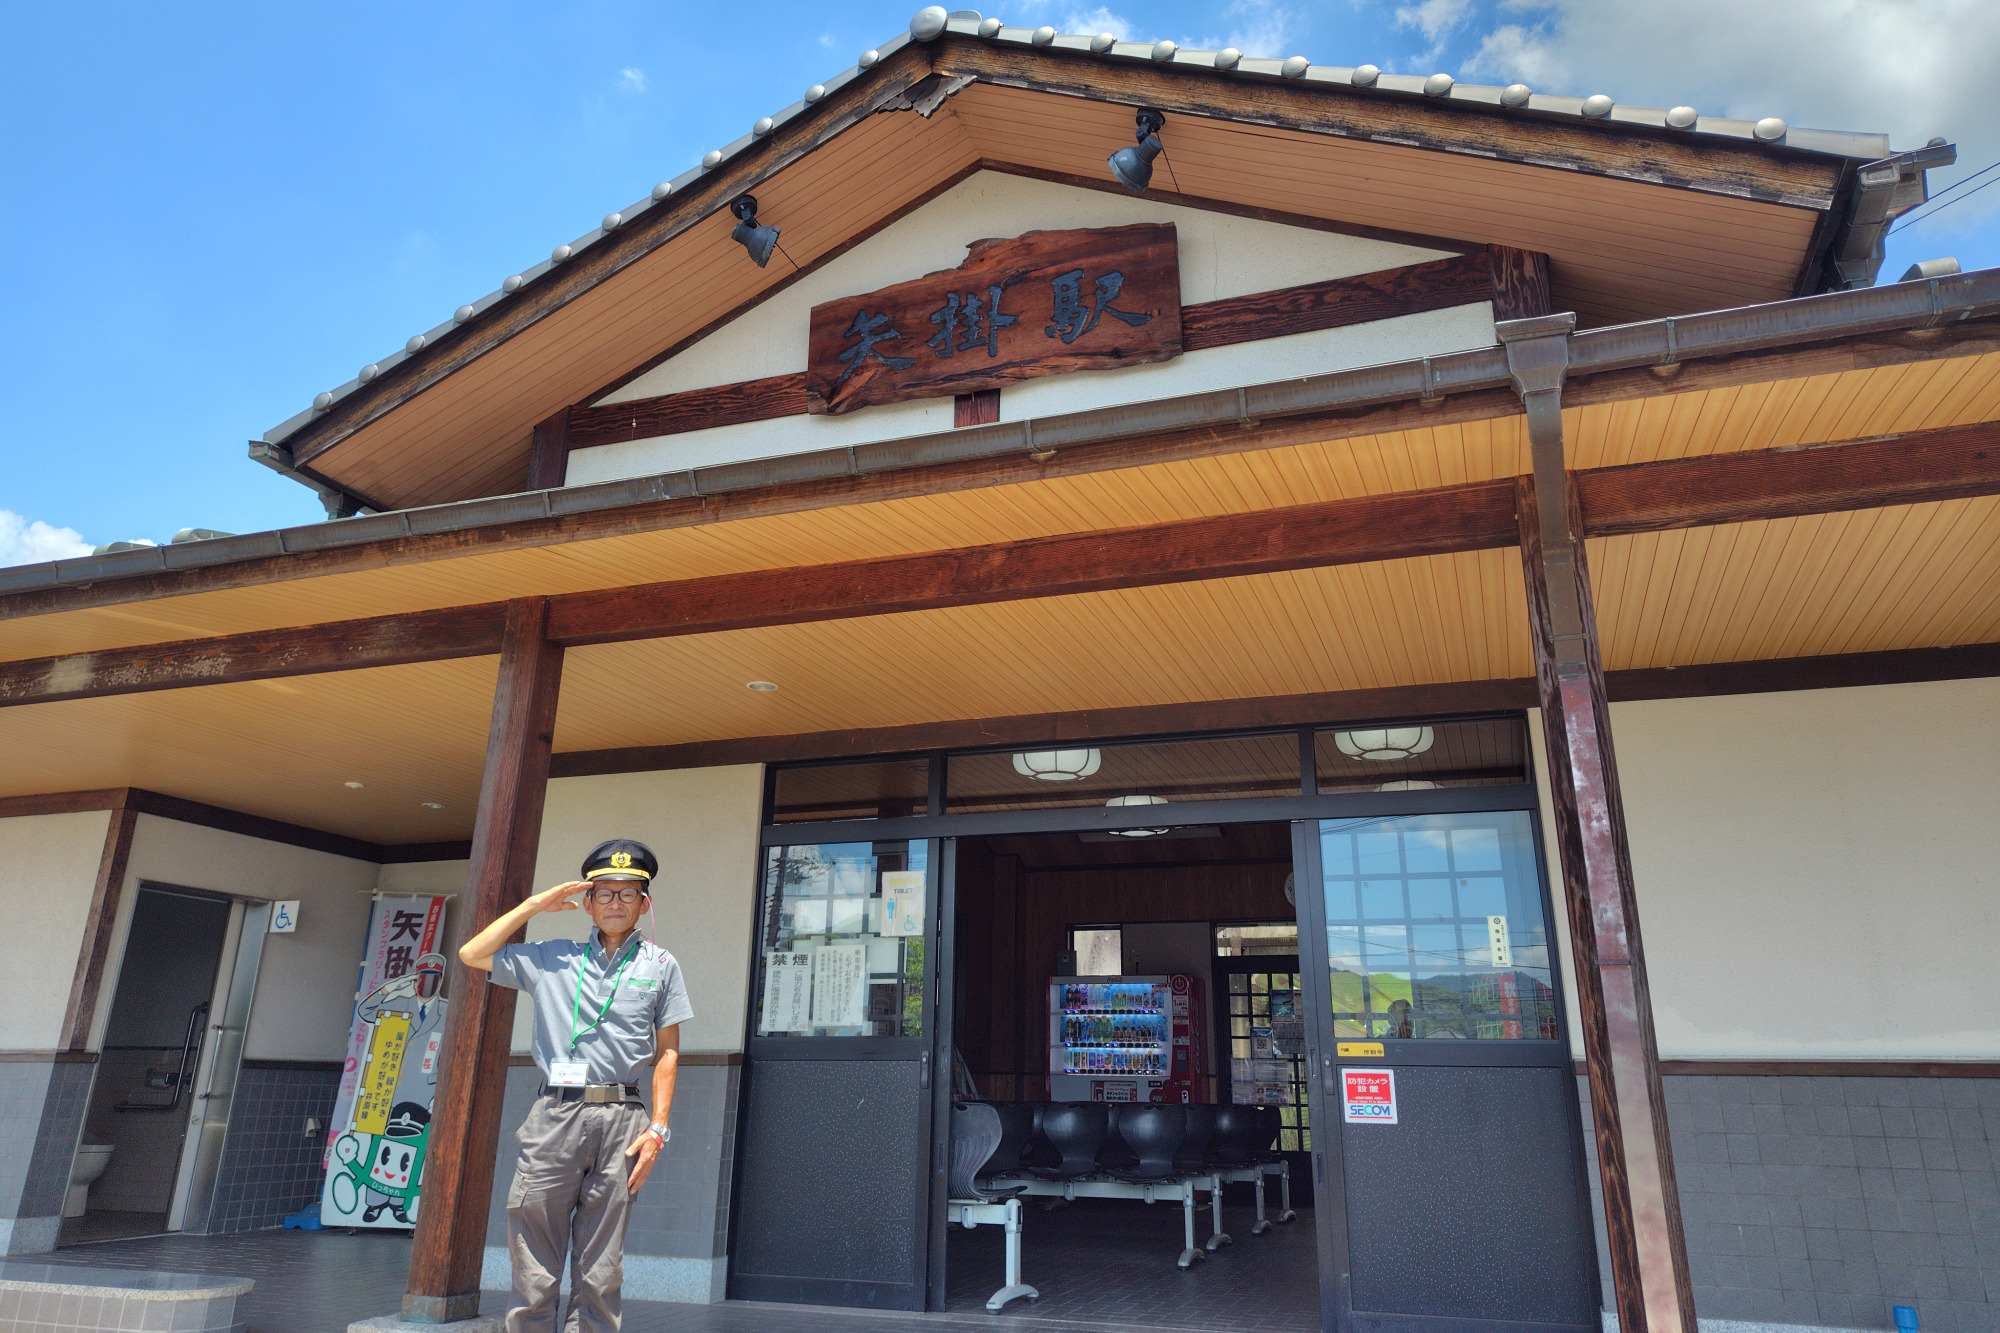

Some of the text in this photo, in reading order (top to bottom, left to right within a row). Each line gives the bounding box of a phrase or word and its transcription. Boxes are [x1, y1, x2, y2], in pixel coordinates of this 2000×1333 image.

[828, 268, 1152, 388] 矢掛駅
[367, 909, 391, 995] スタンプラリーに
[384, 909, 425, 979] 矢掛
[771, 953, 809, 966] 禁煙
[422, 1040, 439, 1070] 駅長
[1347, 1077, 1388, 1085] 防犯カメラ
[1357, 1085, 1379, 1093] 設置
[361, 1092, 373, 1120] 井原線
[1350, 1104, 1391, 1116] SECOM
[371, 1181, 401, 1197] いっちゃん
